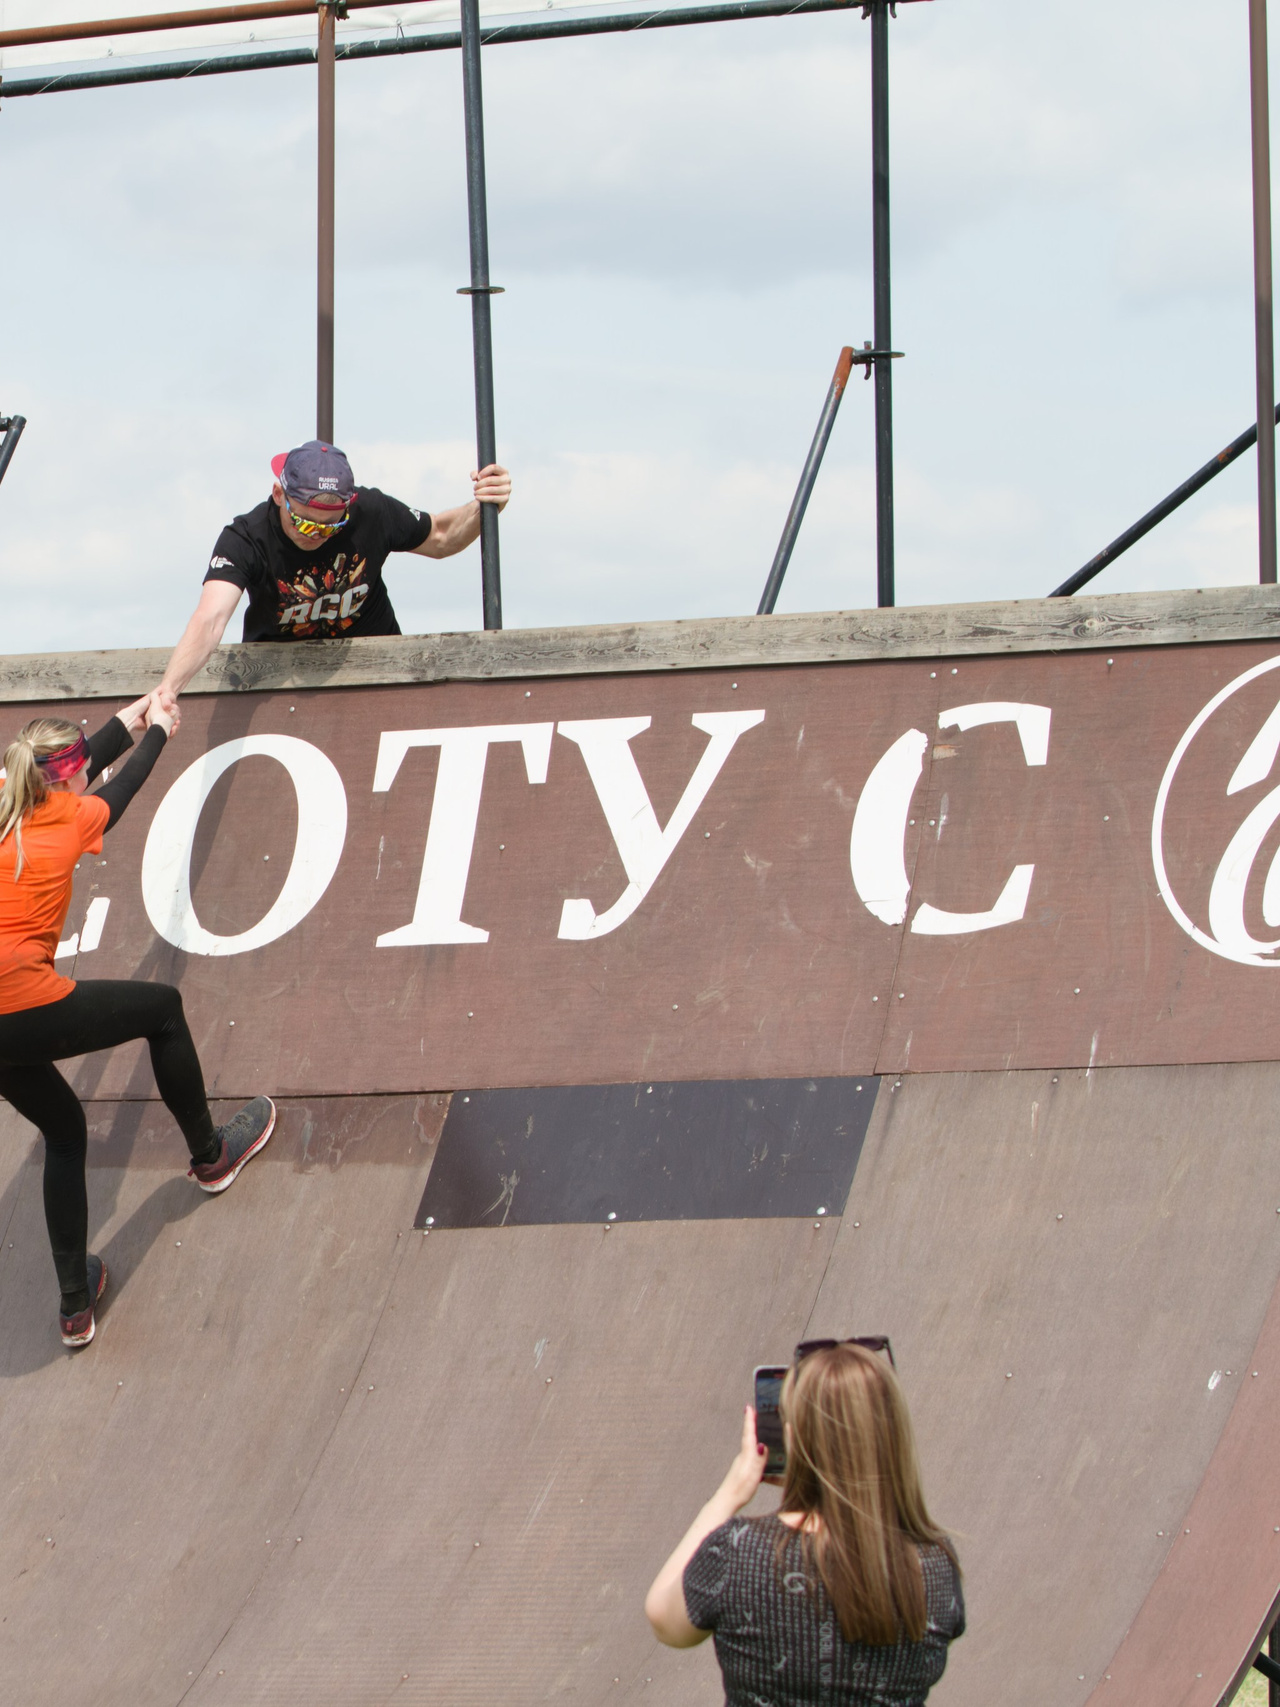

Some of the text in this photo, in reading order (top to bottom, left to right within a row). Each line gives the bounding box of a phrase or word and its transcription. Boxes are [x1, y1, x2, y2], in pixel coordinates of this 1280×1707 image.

[318, 482, 338, 491] URAL
[849, 701, 1052, 936] С
[819, 1621, 833, 1660] TRENDS
